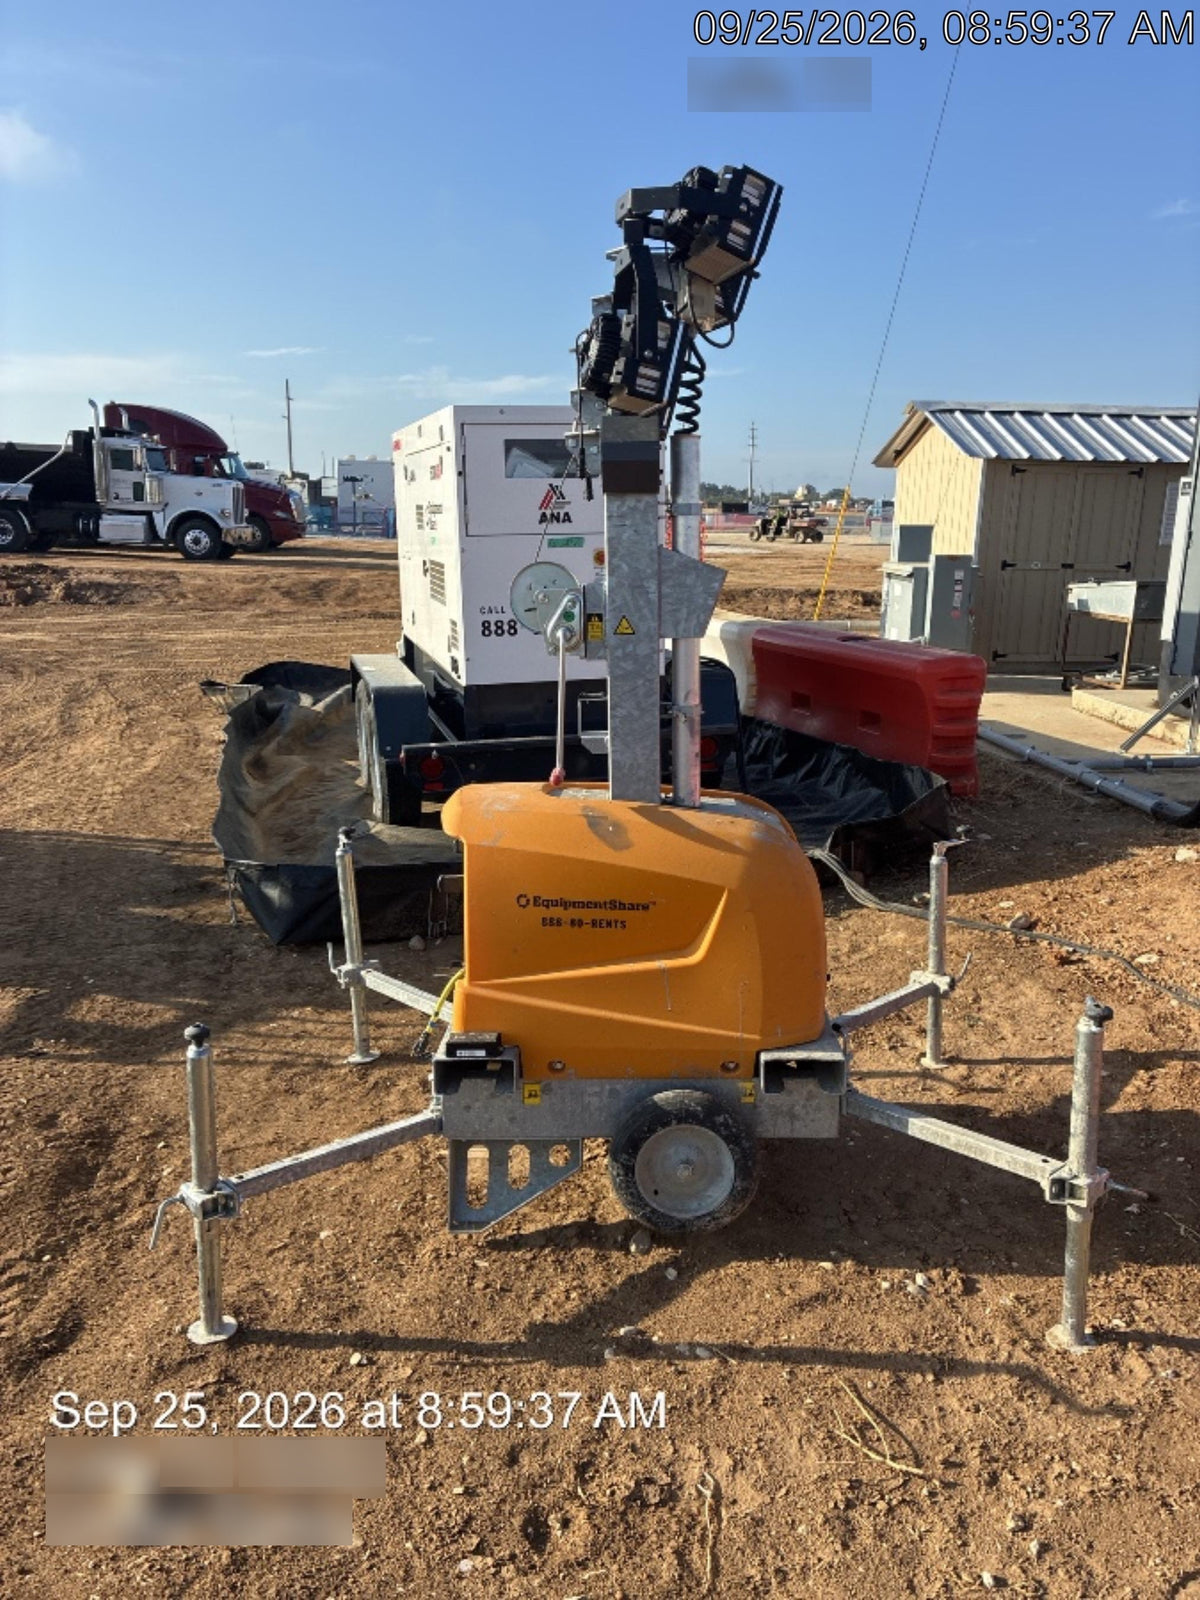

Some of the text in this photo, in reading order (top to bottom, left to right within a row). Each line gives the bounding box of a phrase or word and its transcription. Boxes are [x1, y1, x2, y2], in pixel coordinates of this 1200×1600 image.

[538, 511, 572, 525] ANA
[479, 605, 507, 615] CALL
[481, 619, 518, 638] 888
